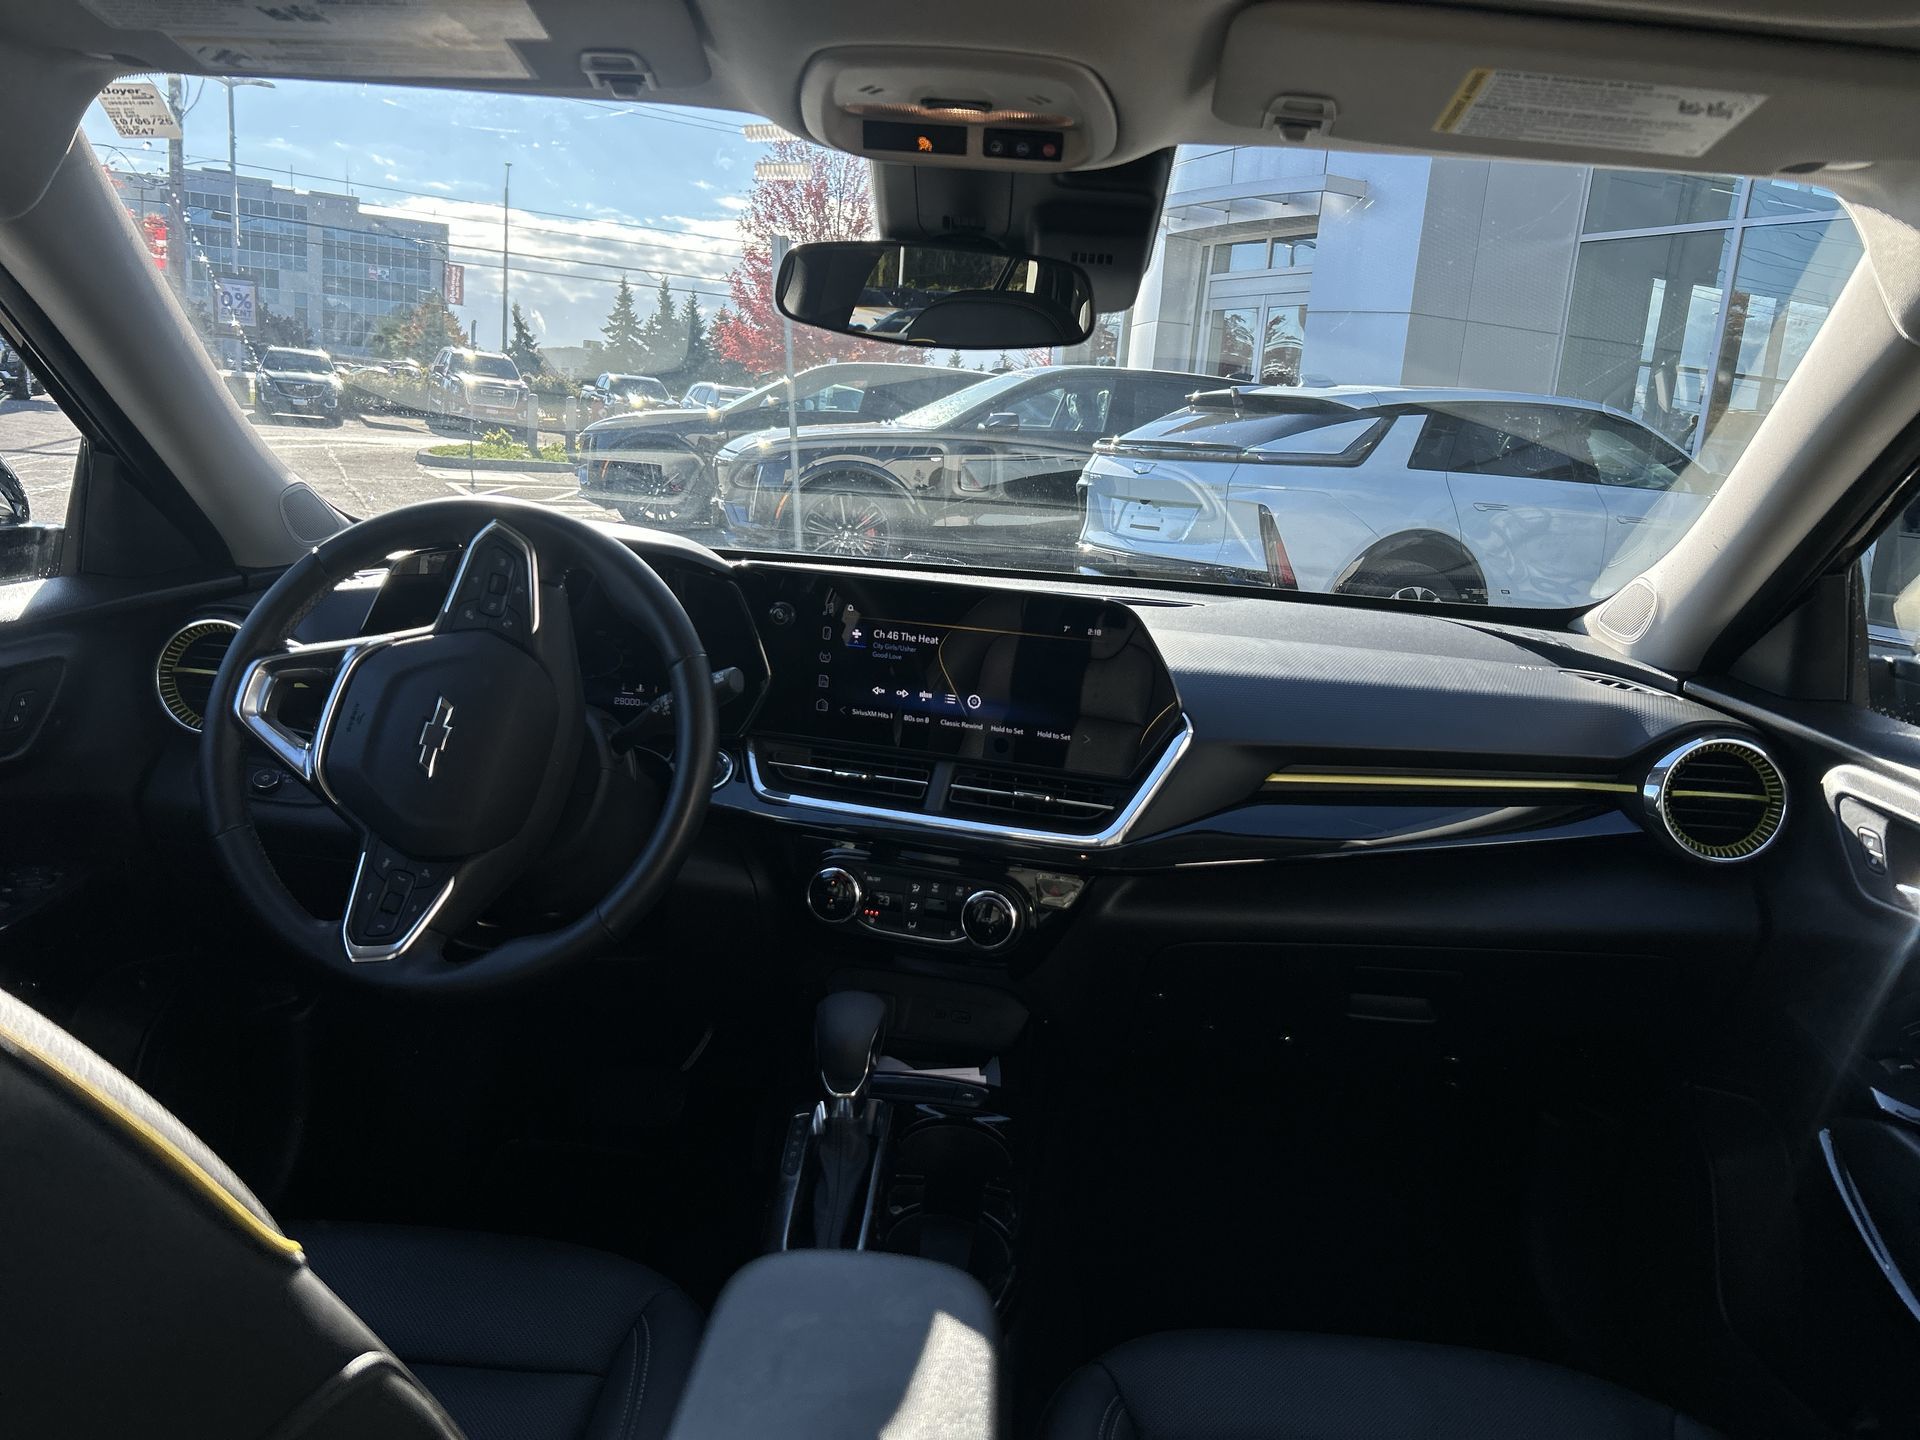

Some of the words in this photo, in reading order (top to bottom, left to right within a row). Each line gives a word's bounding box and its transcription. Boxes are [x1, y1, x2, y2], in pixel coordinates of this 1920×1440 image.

[220, 291, 253, 309] 0%
[220, 307, 253, 318] EVENT
[873, 629, 886, 639] Ch
[887, 630, 899, 641] 46
[901, 632, 917, 642] The
[918, 634, 939, 645] Heat
[872, 642, 884, 650] City
[872, 651, 888, 659] Good
[889, 652, 903, 660] Love
[852, 708, 877, 718] SiriusXM
[877, 710, 889, 719] Hits
[940, 718, 960, 728] Classic
[961, 721, 984, 730] Rewind
[990, 725, 1005, 733] Hold
[1037, 730, 1052, 738] Hold
[1060, 733, 1071, 741] Set
